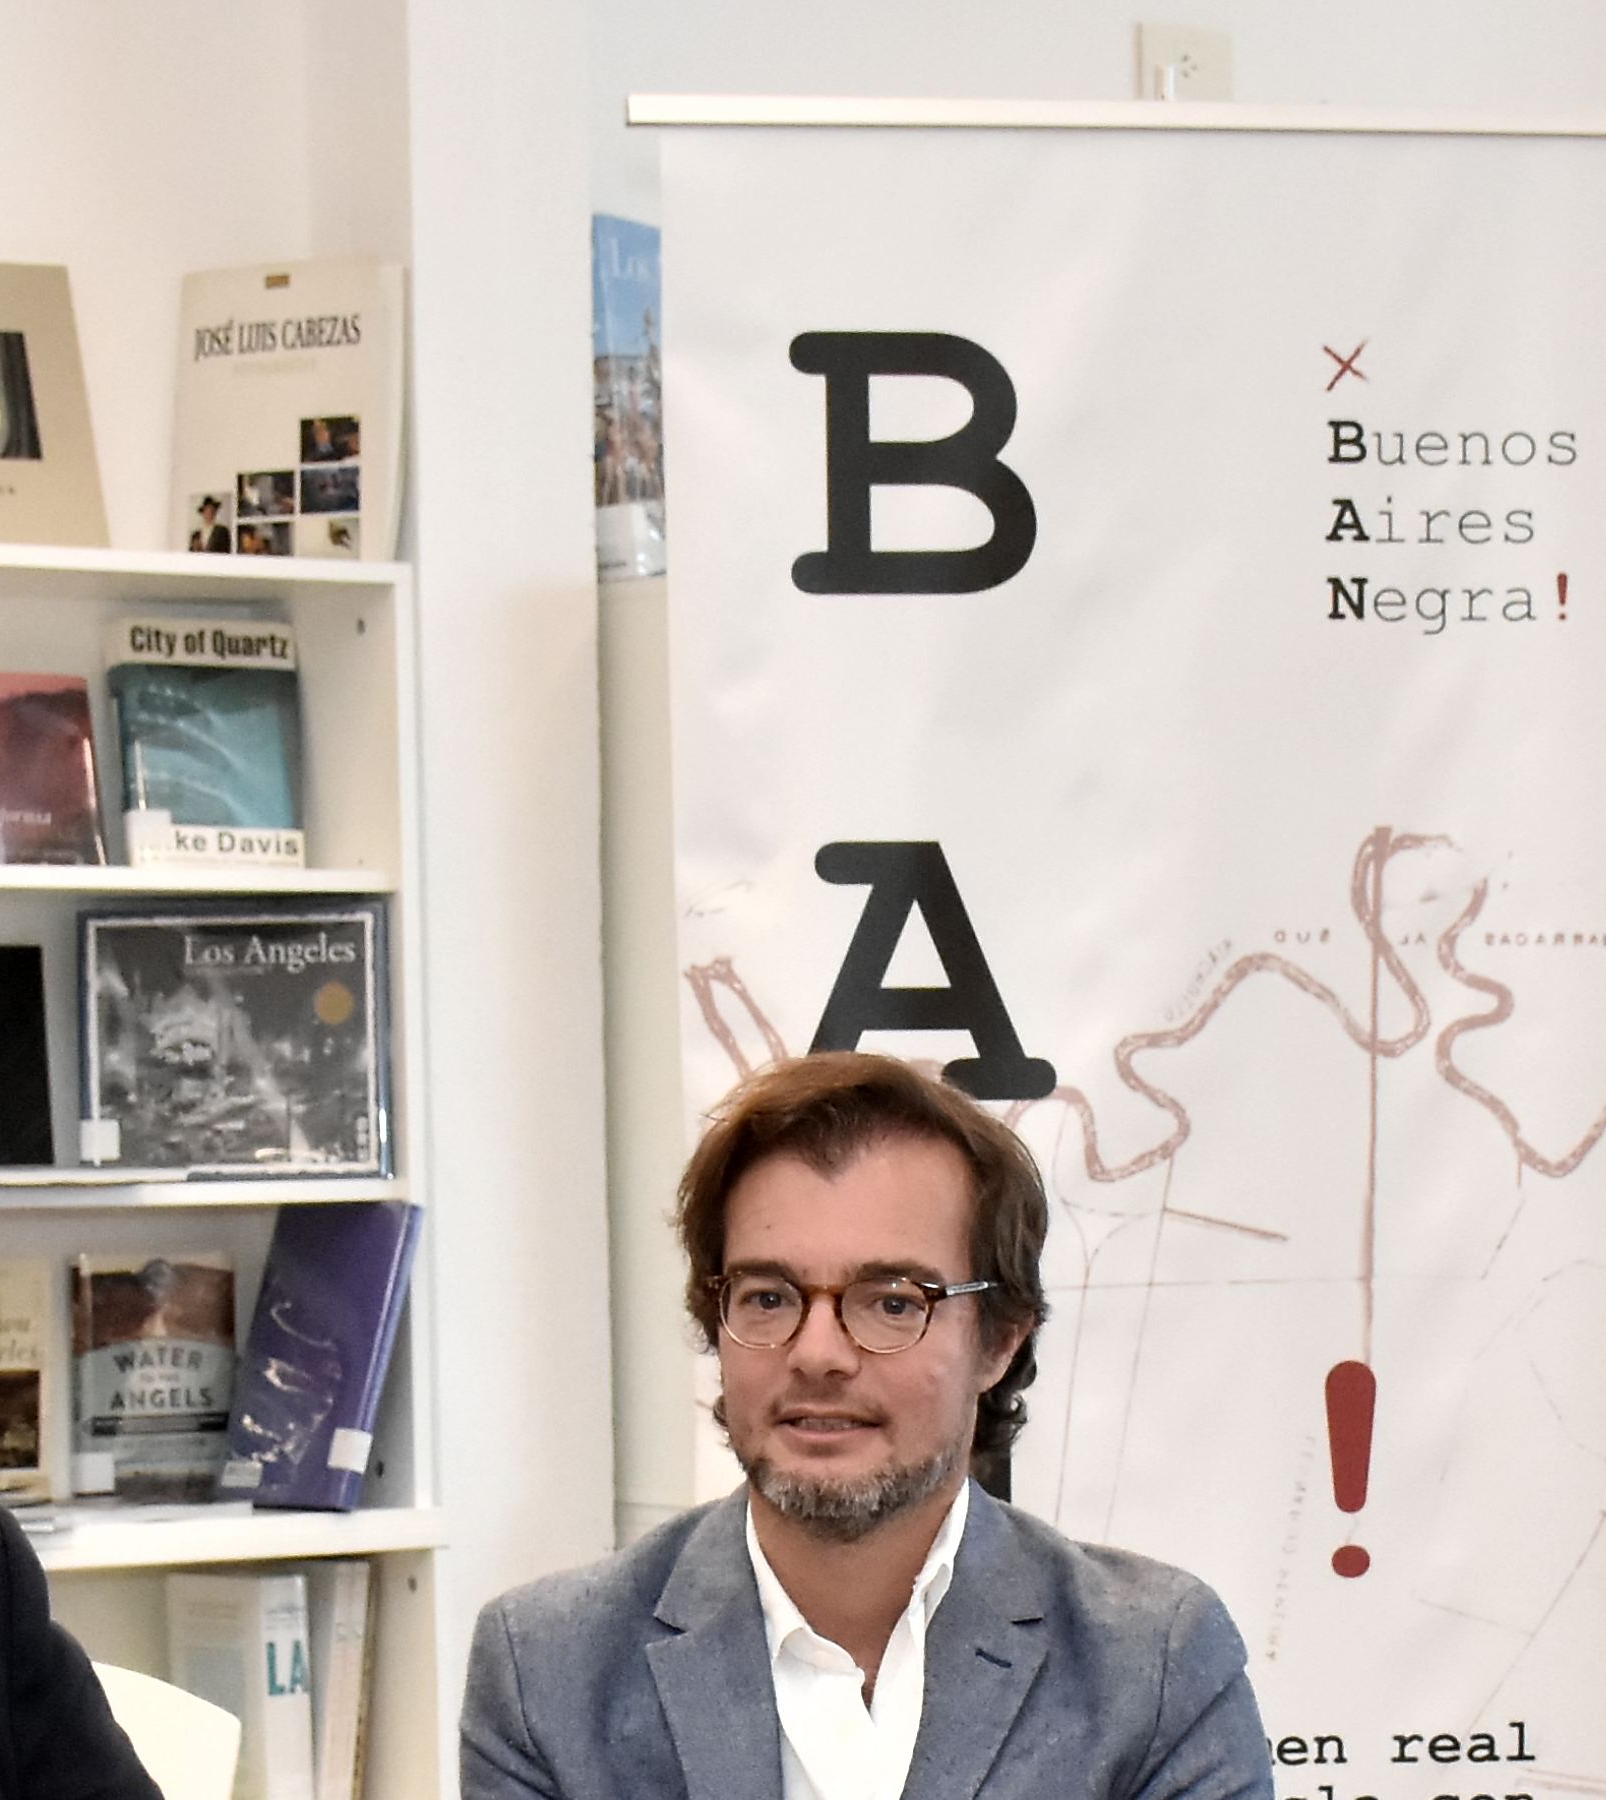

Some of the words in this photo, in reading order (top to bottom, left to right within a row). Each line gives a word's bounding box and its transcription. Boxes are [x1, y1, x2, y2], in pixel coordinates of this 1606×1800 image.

[193, 318, 235, 362] JOSÉ
[238, 322, 277, 354] LUIS
[281, 313, 361, 351] CABEZAS
[789, 331, 1037, 595] B
[1326, 419, 1578, 467] Buenos
[1324, 496, 1535, 545] Aires
[1326, 572, 1569, 635] Negra!
[130, 625, 176, 657] City
[184, 629, 206, 653] of
[212, 629, 289, 659] Quartz
[218, 830, 298, 856] Davis
[184, 934, 235, 965] Los
[243, 931, 356, 974] Angeles
[807, 841, 1057, 1101] A
[113, 1346, 204, 1374] WATER
[109, 1386, 213, 1412] ANGELS
[266, 1640, 308, 1696] LA
[1268, 1734, 1349, 1766] en
[1391, 1721, 1537, 1764] real
